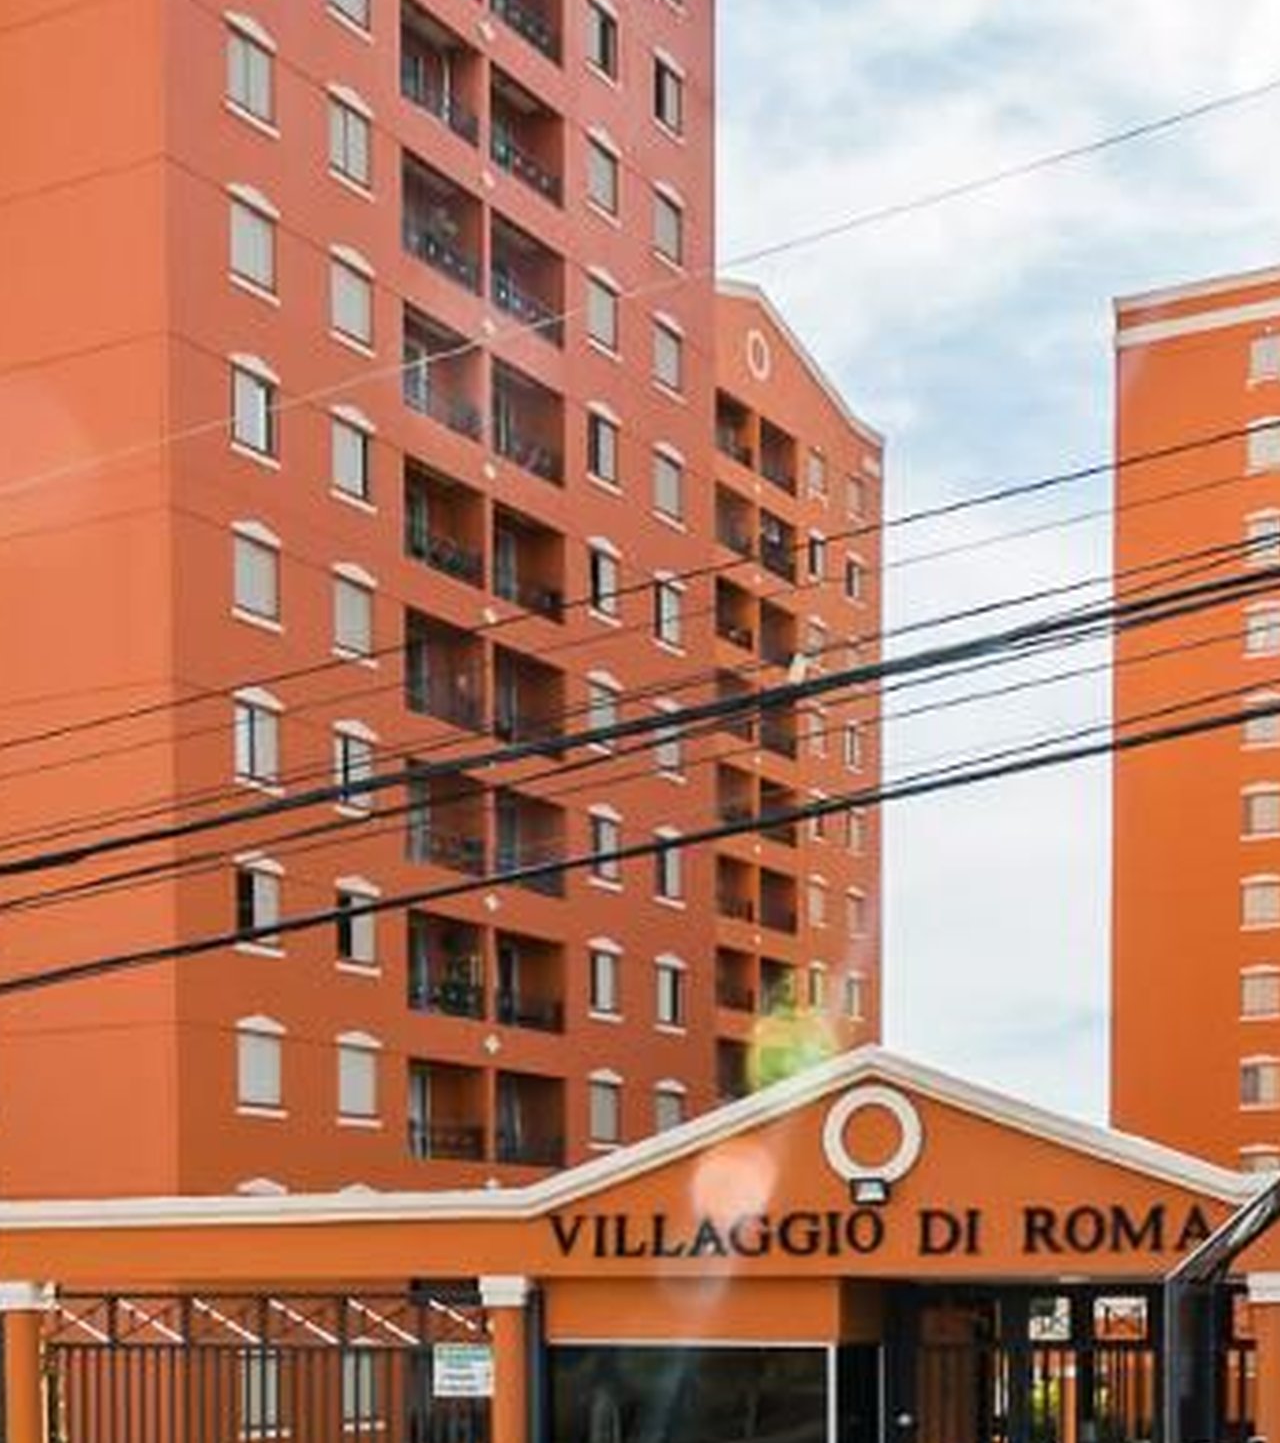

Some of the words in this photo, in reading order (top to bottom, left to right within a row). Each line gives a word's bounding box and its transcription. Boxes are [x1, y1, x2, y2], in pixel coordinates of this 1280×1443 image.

[549, 1209, 884, 1258] VILLAGGIO
[919, 1209, 979, 1256] DI
[1022, 1205, 1213, 1255] ROMA
